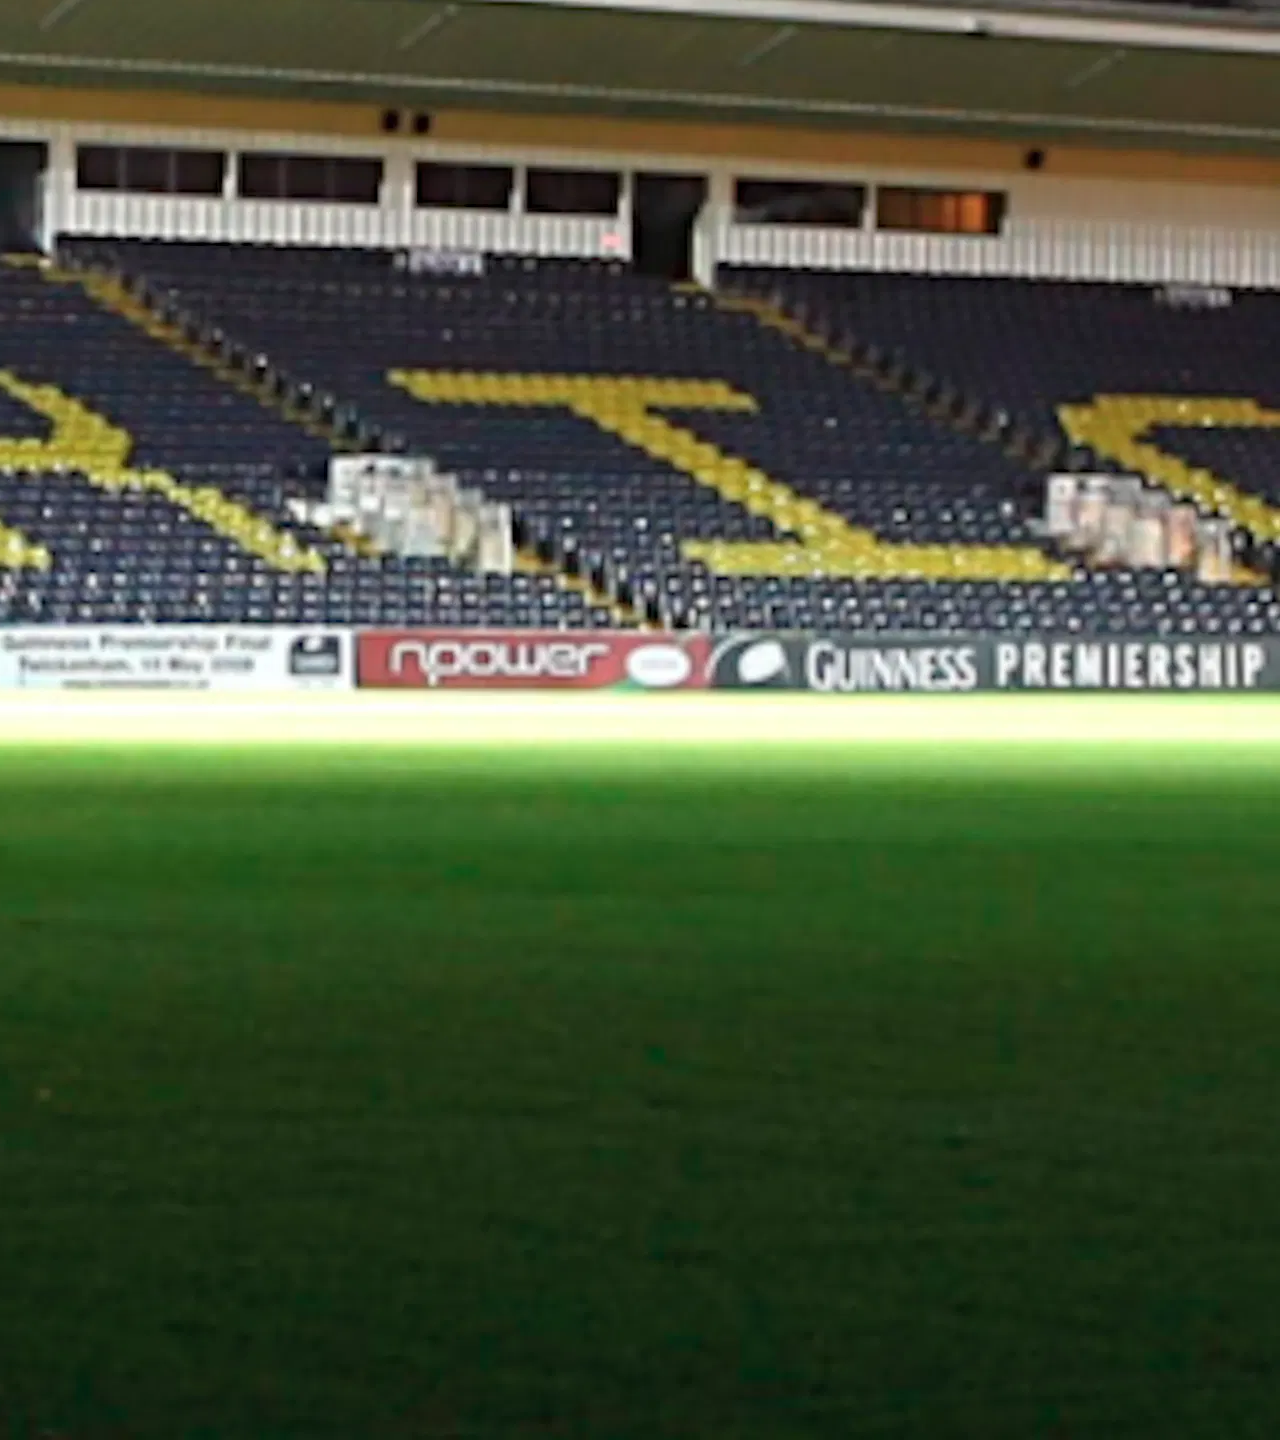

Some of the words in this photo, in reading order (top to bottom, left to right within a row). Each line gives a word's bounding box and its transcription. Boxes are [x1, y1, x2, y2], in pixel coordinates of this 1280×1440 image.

[389, 640, 610, 687] npower
[805, 639, 978, 693] GUINNESS
[996, 640, 1266, 689] PREMIERSHIP
